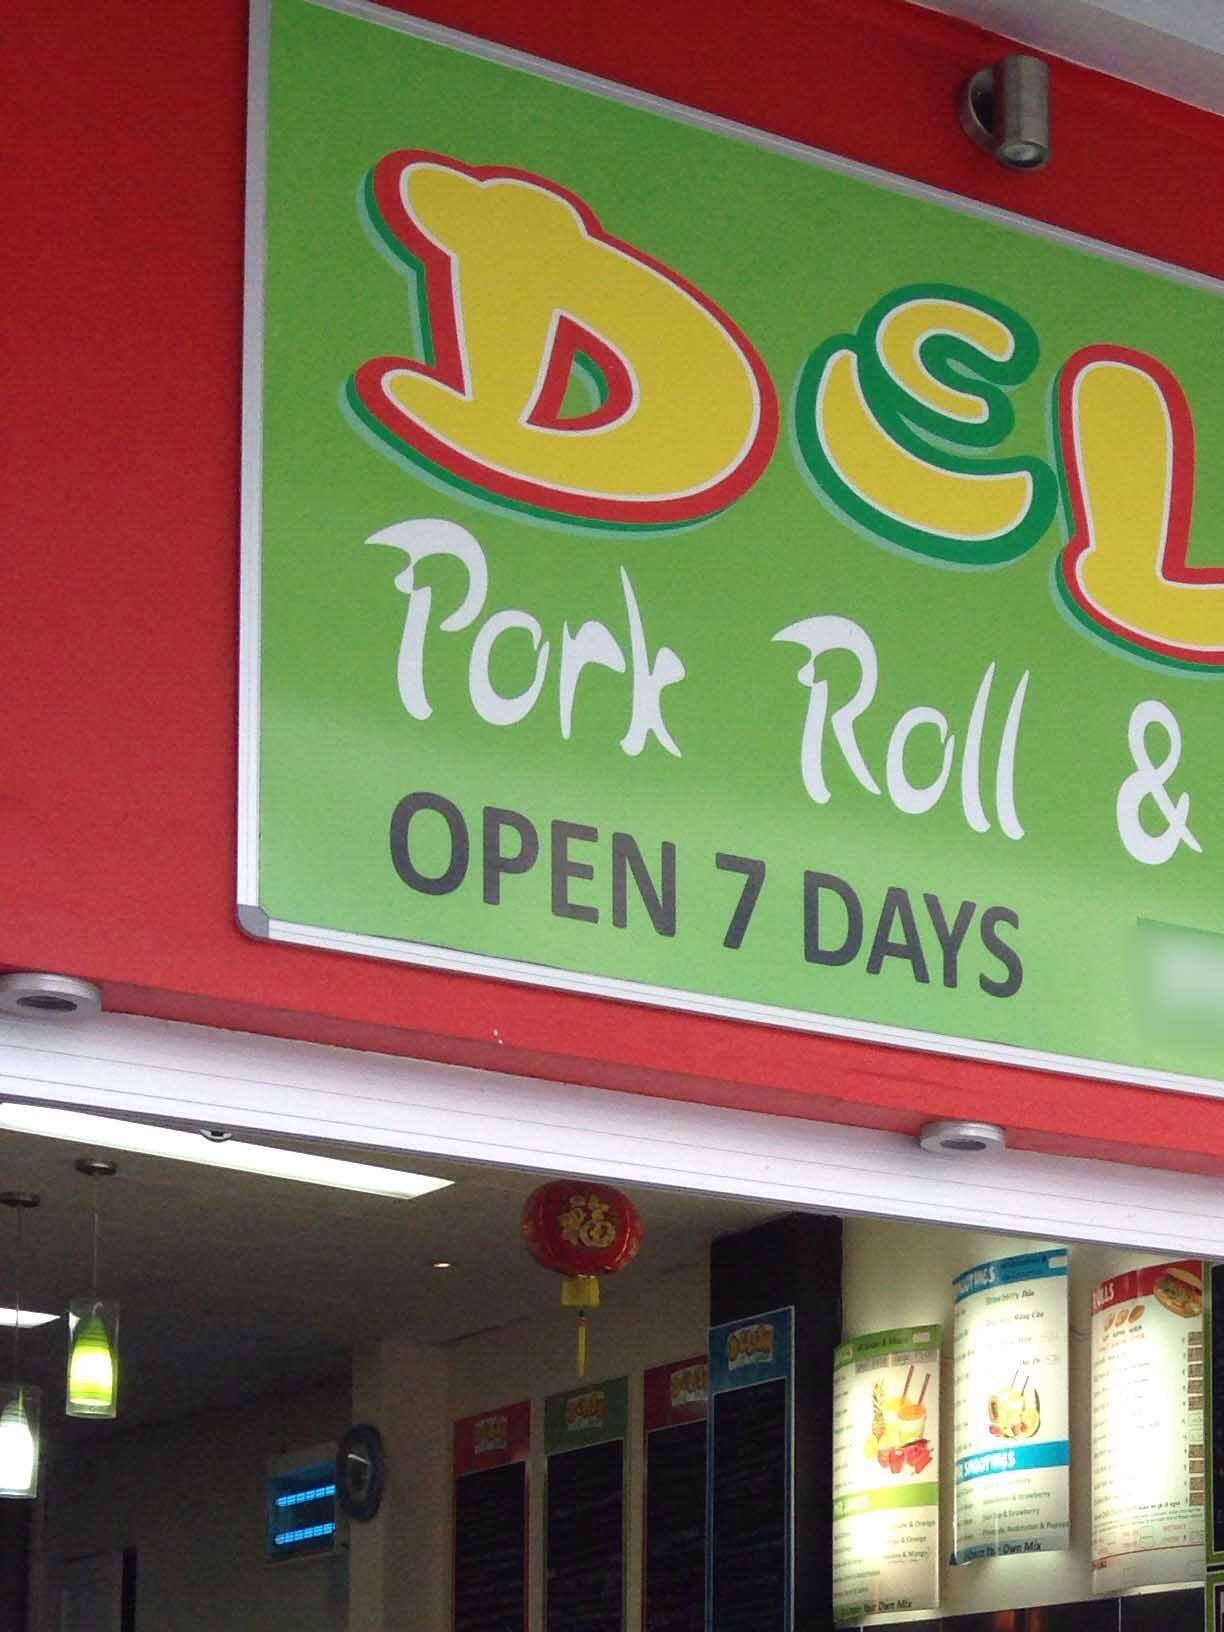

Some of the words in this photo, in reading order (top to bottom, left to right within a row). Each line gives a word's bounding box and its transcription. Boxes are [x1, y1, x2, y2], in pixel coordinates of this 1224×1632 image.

[363, 517, 686, 758] Pork
[771, 613, 1030, 840] Roll
[1116, 699, 1203, 865] &
[388, 790, 677, 936] OPEN
[715, 852, 766, 949] 7
[803, 869, 1024, 998] DAYS
